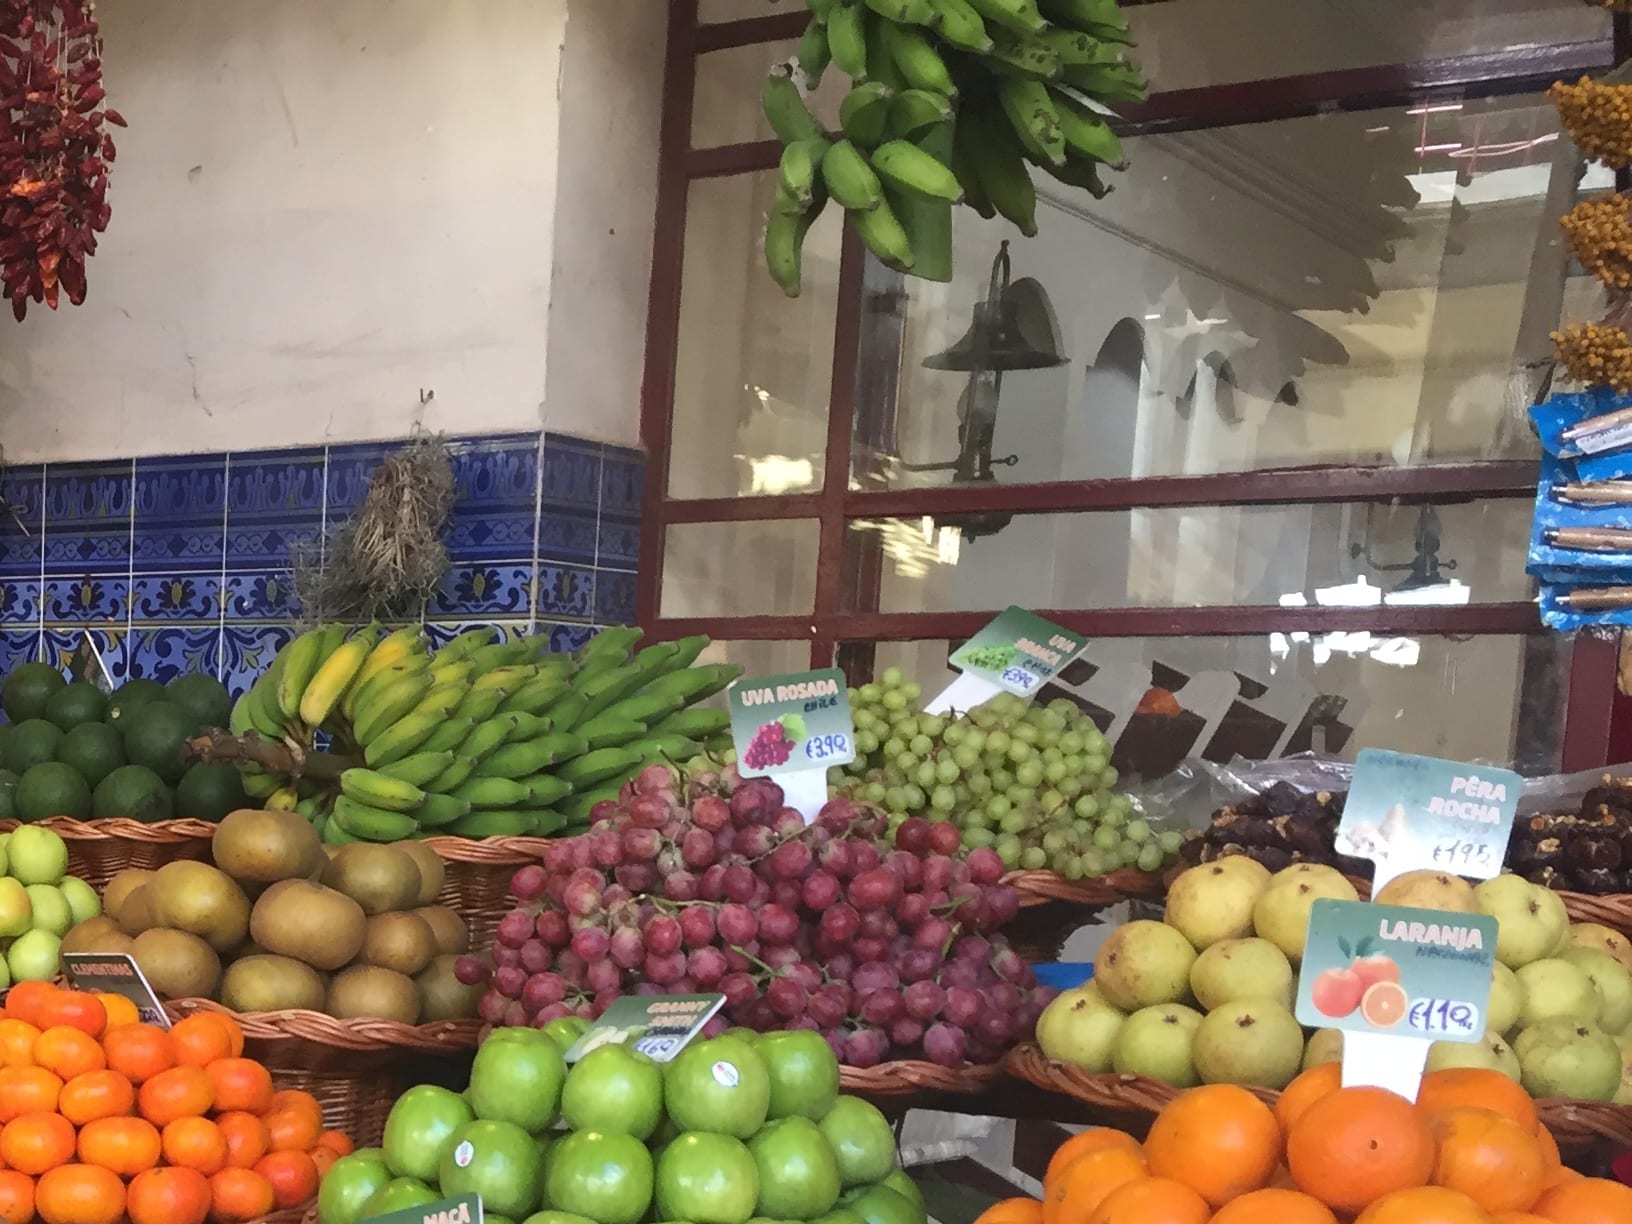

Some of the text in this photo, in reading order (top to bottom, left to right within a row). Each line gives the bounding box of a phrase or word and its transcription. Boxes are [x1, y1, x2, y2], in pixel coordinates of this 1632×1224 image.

[741, 679, 839, 706] UVA ROSADA
[1450, 775, 1507, 802] PÊRA
[1428, 797, 1501, 825] ROCHA
[1379, 918, 1483, 950] LARANJA
[646, 1000, 711, 1014] GRANNY
